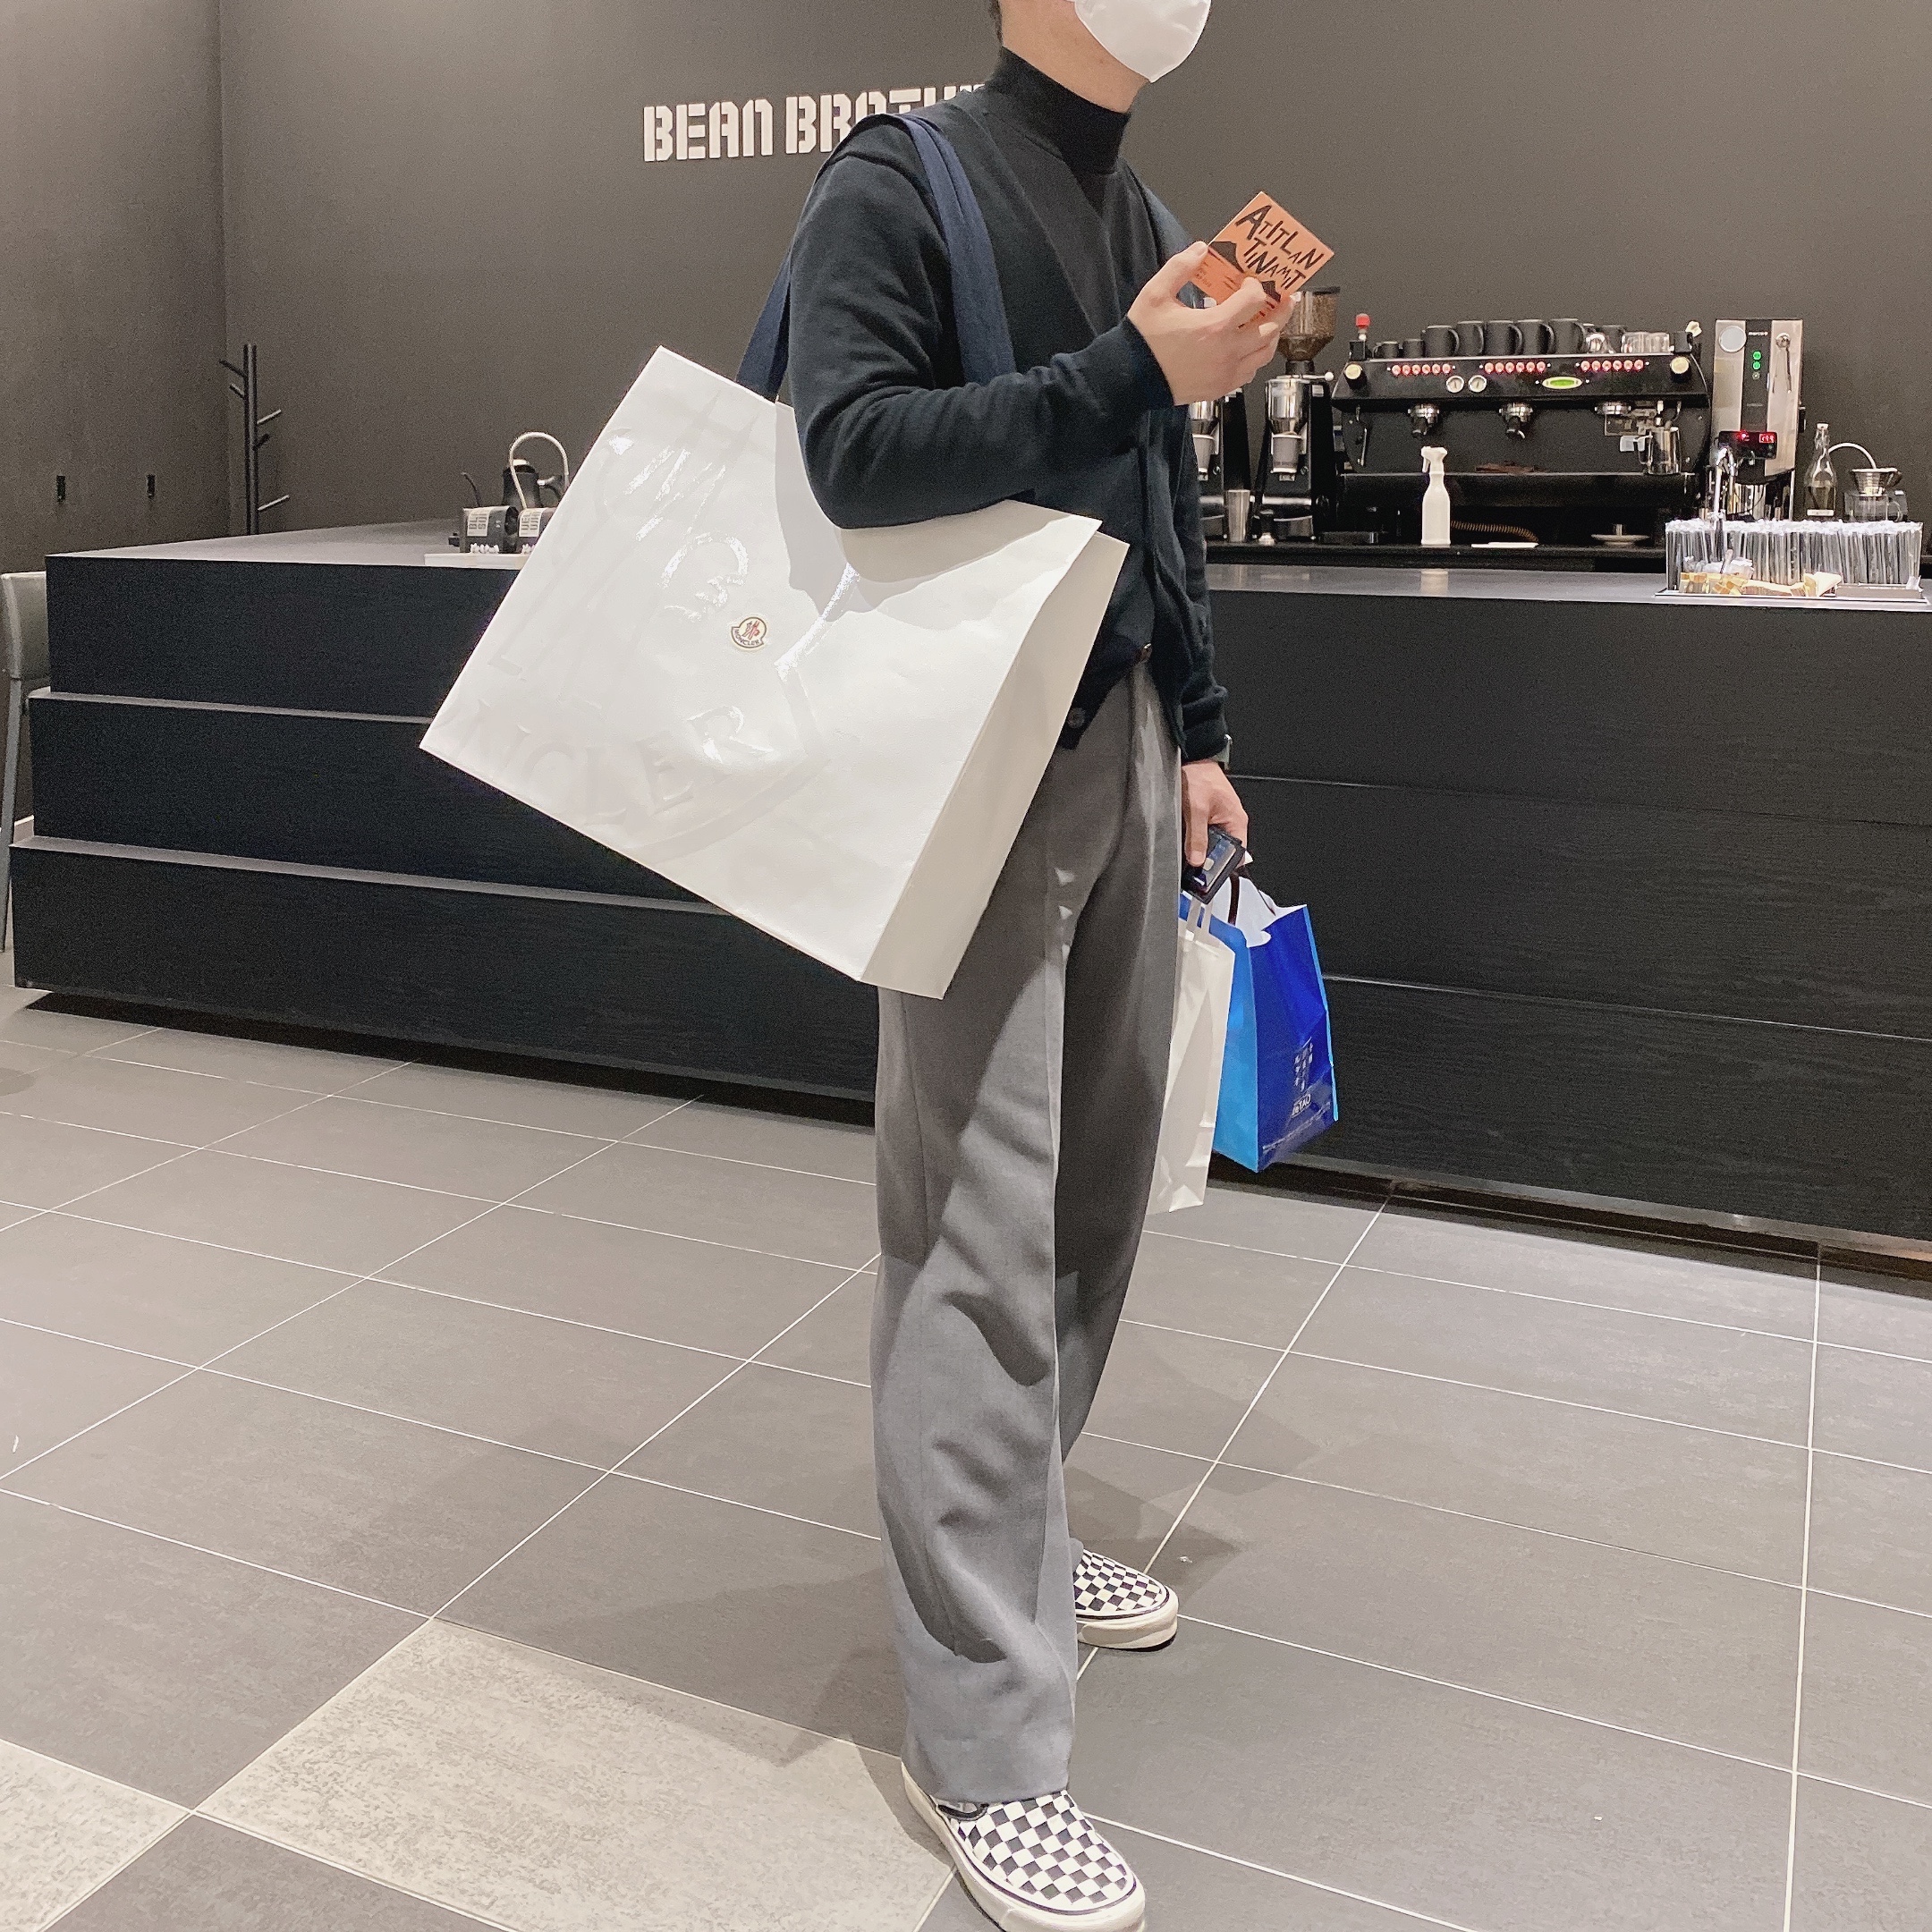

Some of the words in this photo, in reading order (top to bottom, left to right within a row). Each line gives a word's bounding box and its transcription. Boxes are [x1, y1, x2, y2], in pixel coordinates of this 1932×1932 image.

[643, 99, 773, 162] BEAN
[1234, 205, 1324, 269] ATITLAN
[733, 629, 760, 646] MONCLER
